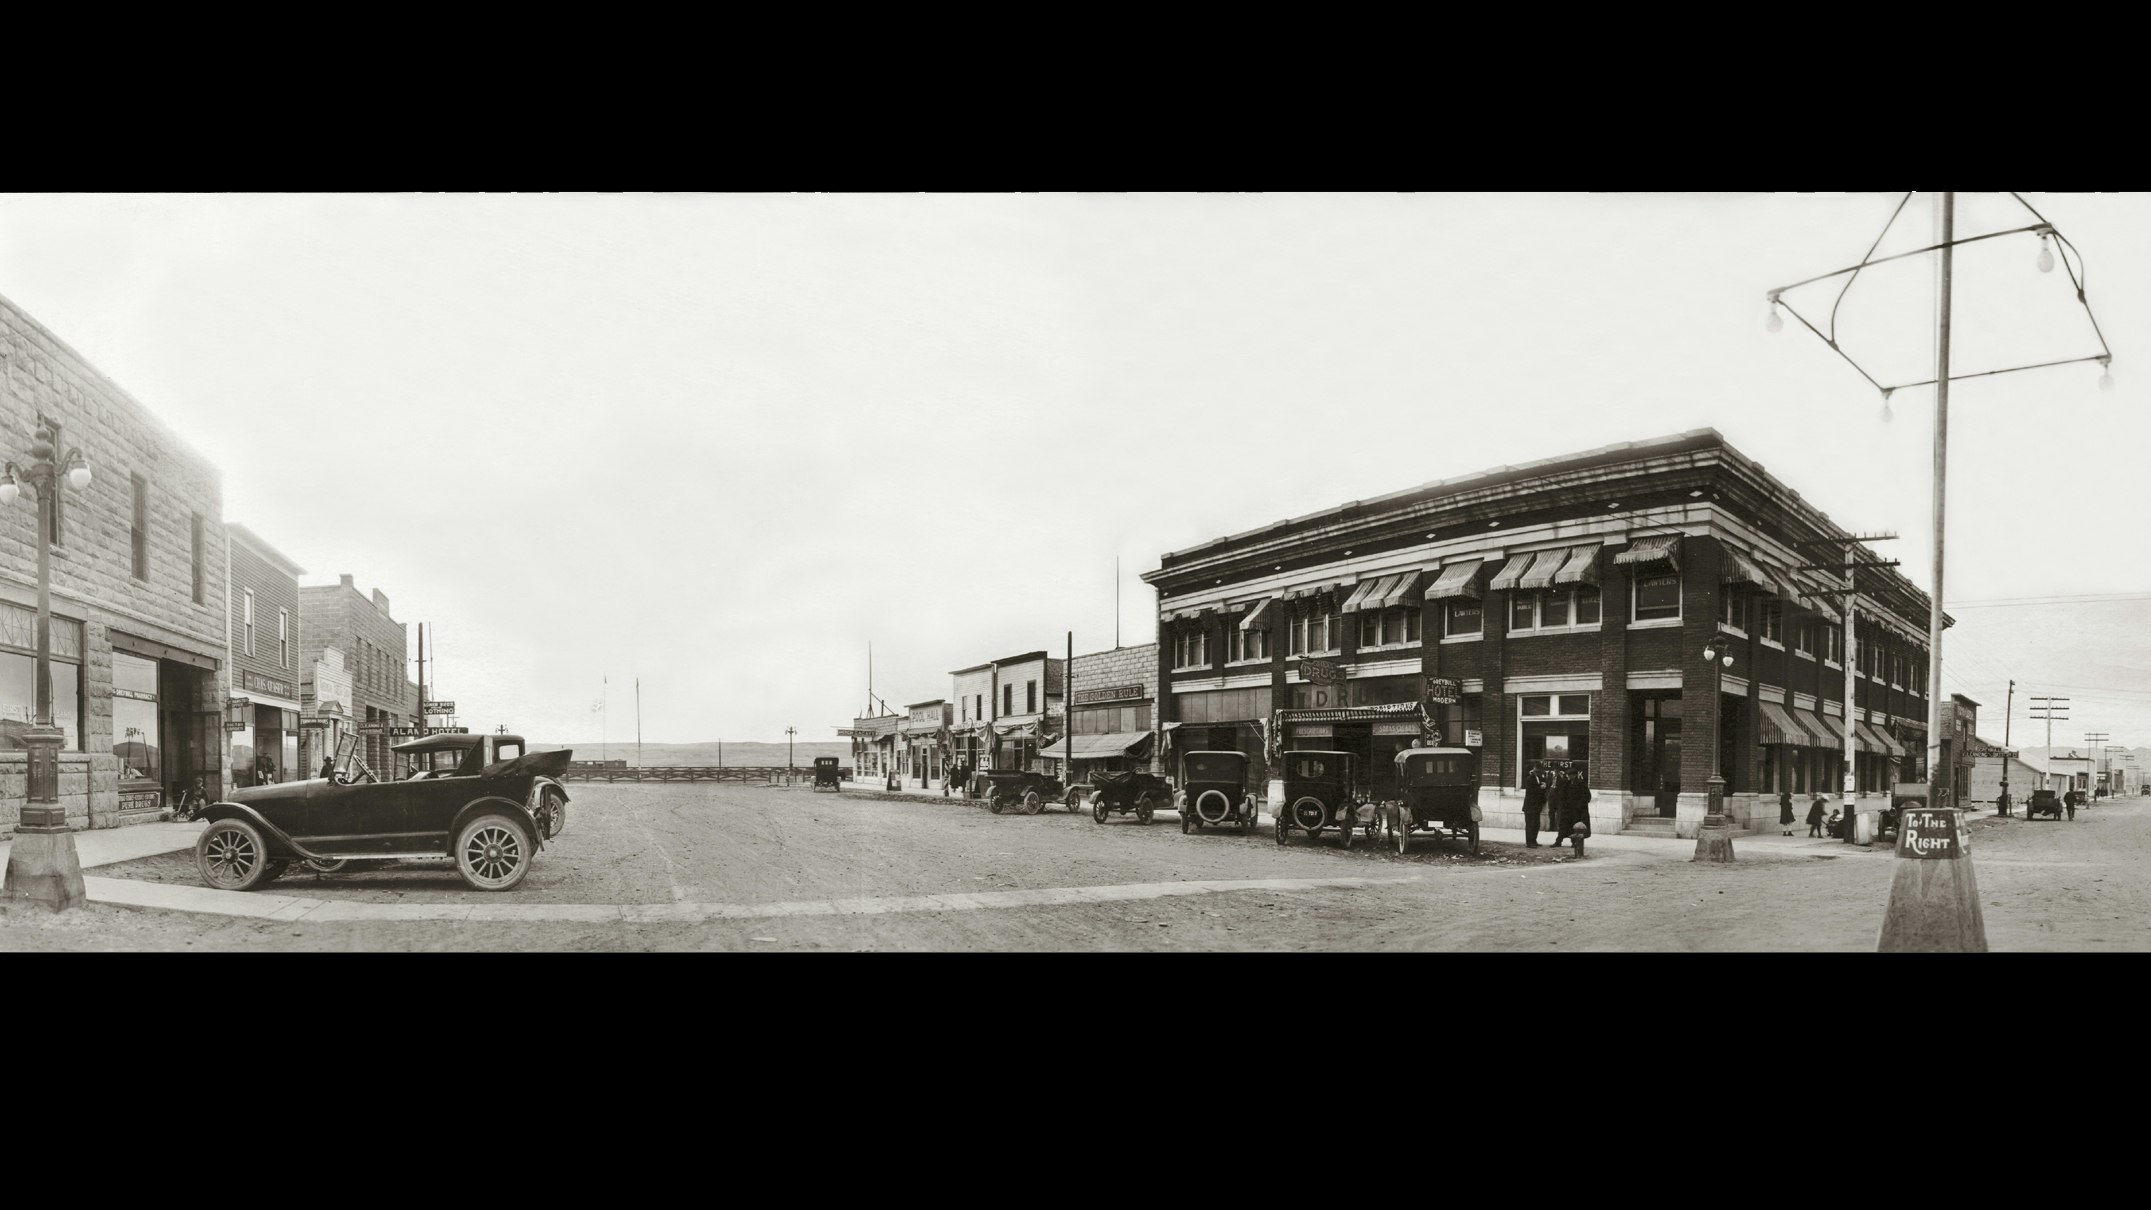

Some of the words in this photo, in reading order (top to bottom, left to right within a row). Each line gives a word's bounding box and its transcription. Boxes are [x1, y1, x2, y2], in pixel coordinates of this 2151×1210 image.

[1304, 666, 1345, 680] DRUGS
[1089, 690, 1115, 701] GOLDEN
[1118, 688, 1138, 698] RULE
[1427, 685, 1461, 698] HOTEL
